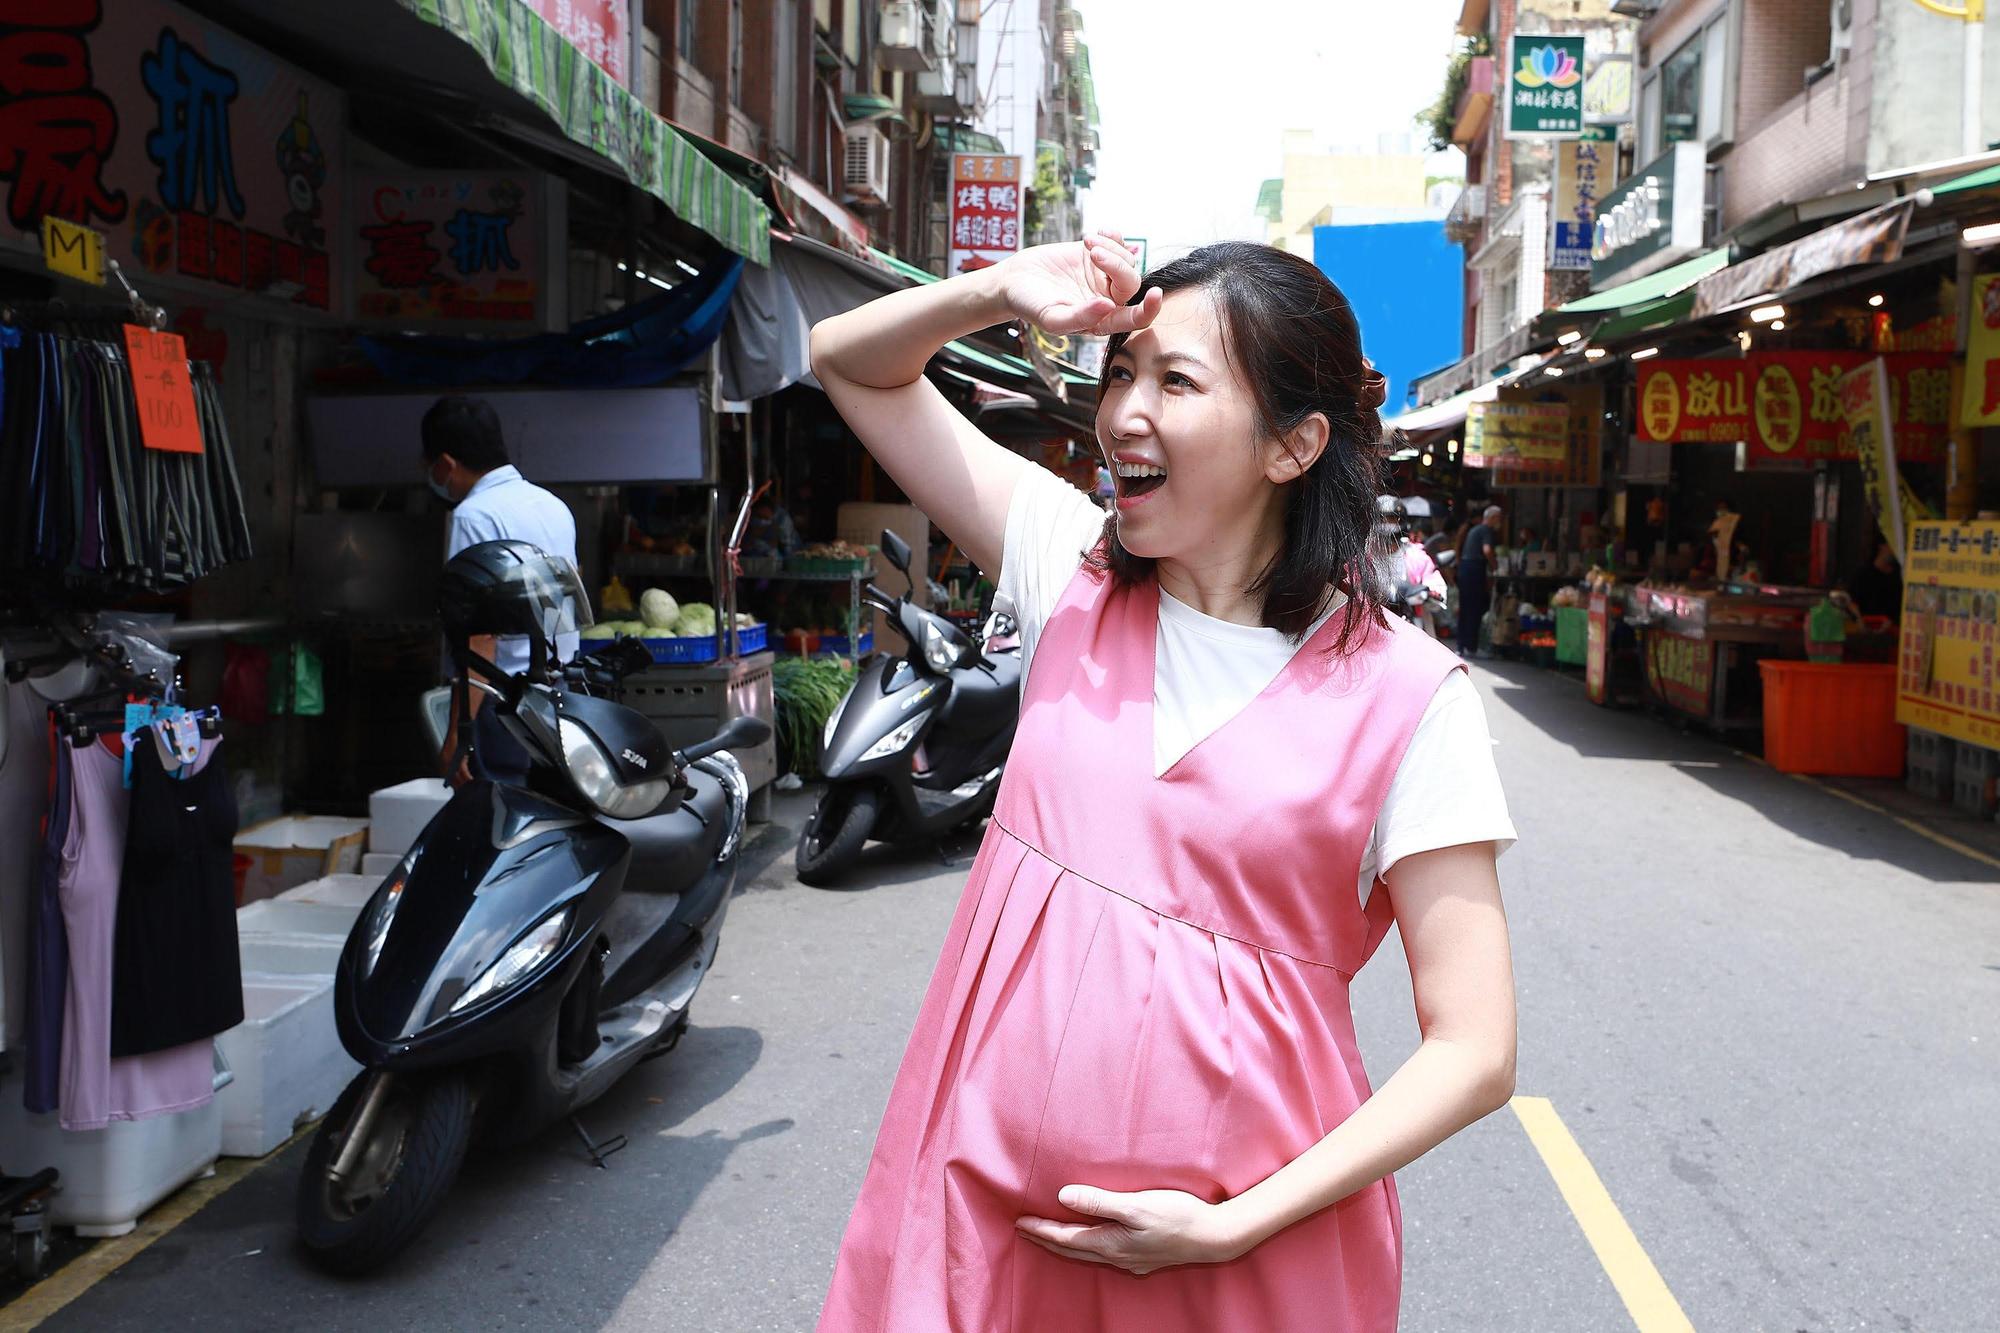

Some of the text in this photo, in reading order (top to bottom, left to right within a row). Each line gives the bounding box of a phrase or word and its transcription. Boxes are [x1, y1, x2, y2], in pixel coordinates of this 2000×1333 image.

[957, 184, 1017, 213] 烤鴨
[50, 224, 88, 272] M
[1808, 365, 1950, 426] 放雞
[147, 396, 184, 430] 100
[621, 748, 648, 769] SYM
